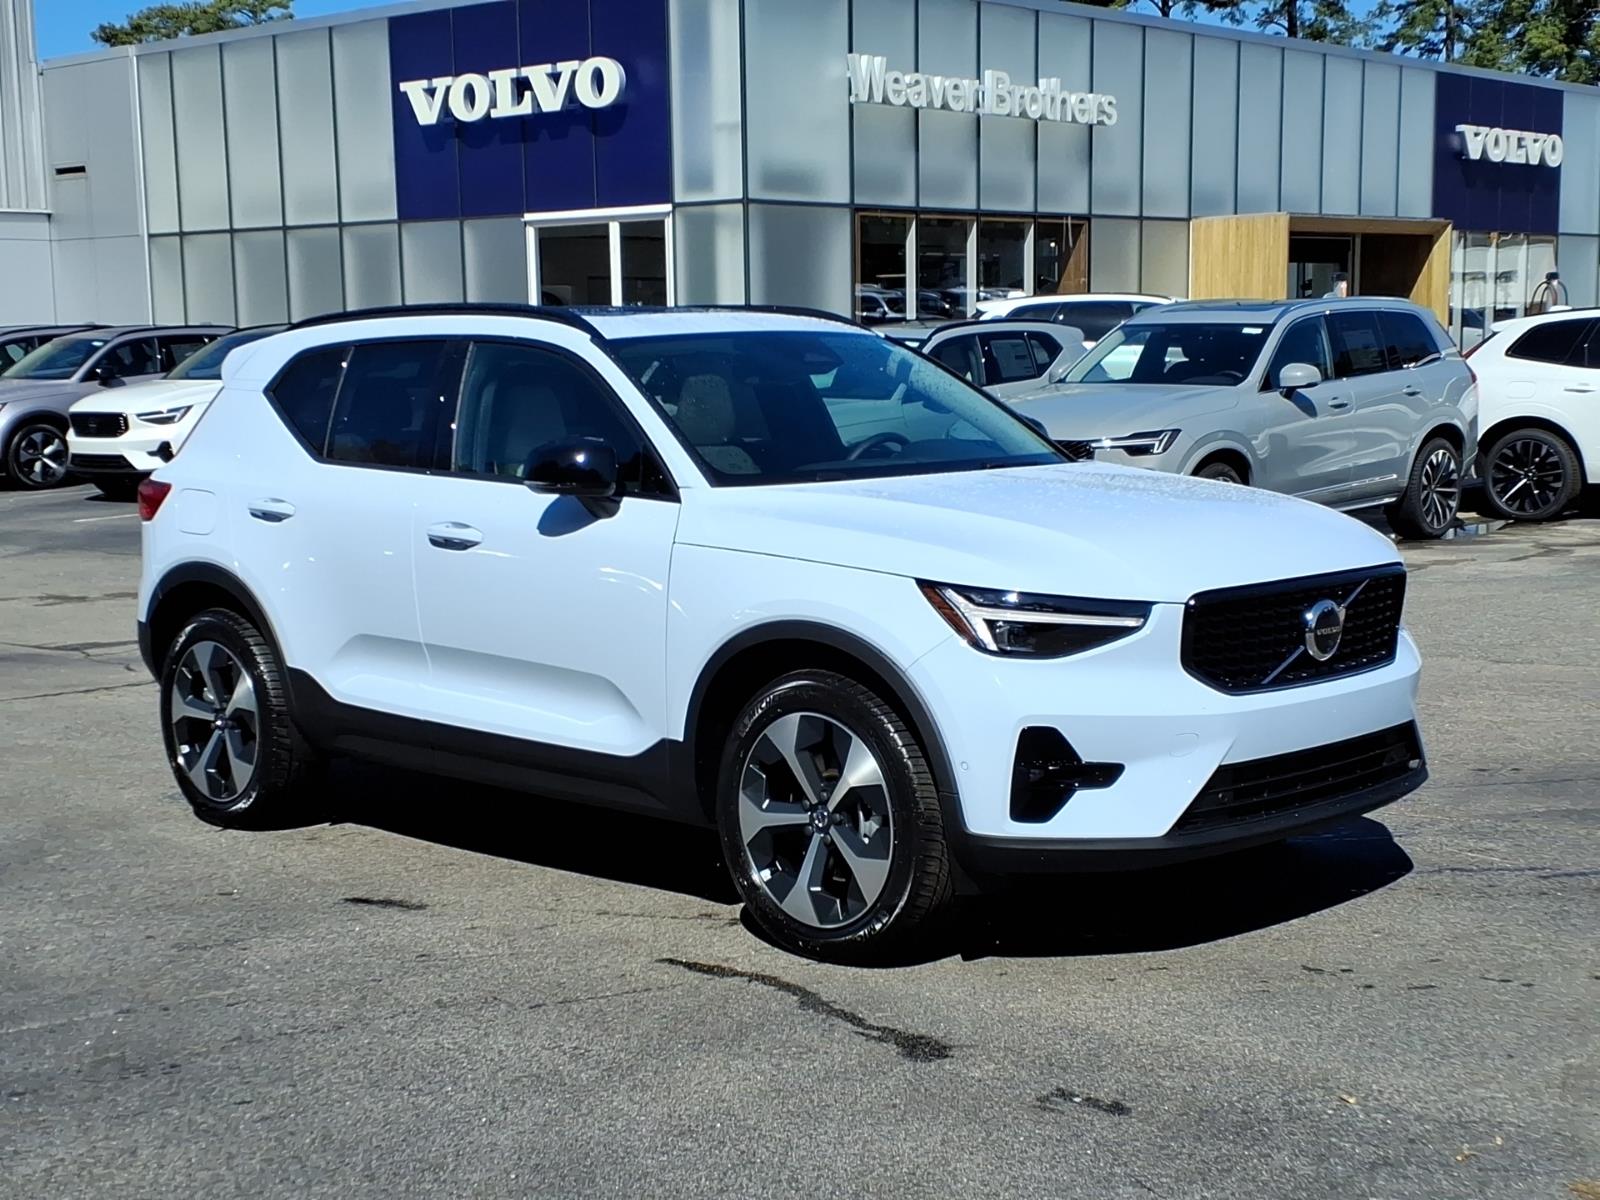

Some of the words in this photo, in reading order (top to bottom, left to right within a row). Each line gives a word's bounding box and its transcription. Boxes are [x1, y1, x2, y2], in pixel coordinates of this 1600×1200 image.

[400, 56, 625, 126] VOLVO
[847, 54, 979, 112] Weaver
[984, 69, 1118, 126] Brothers
[1456, 125, 1563, 167] VOLVO
